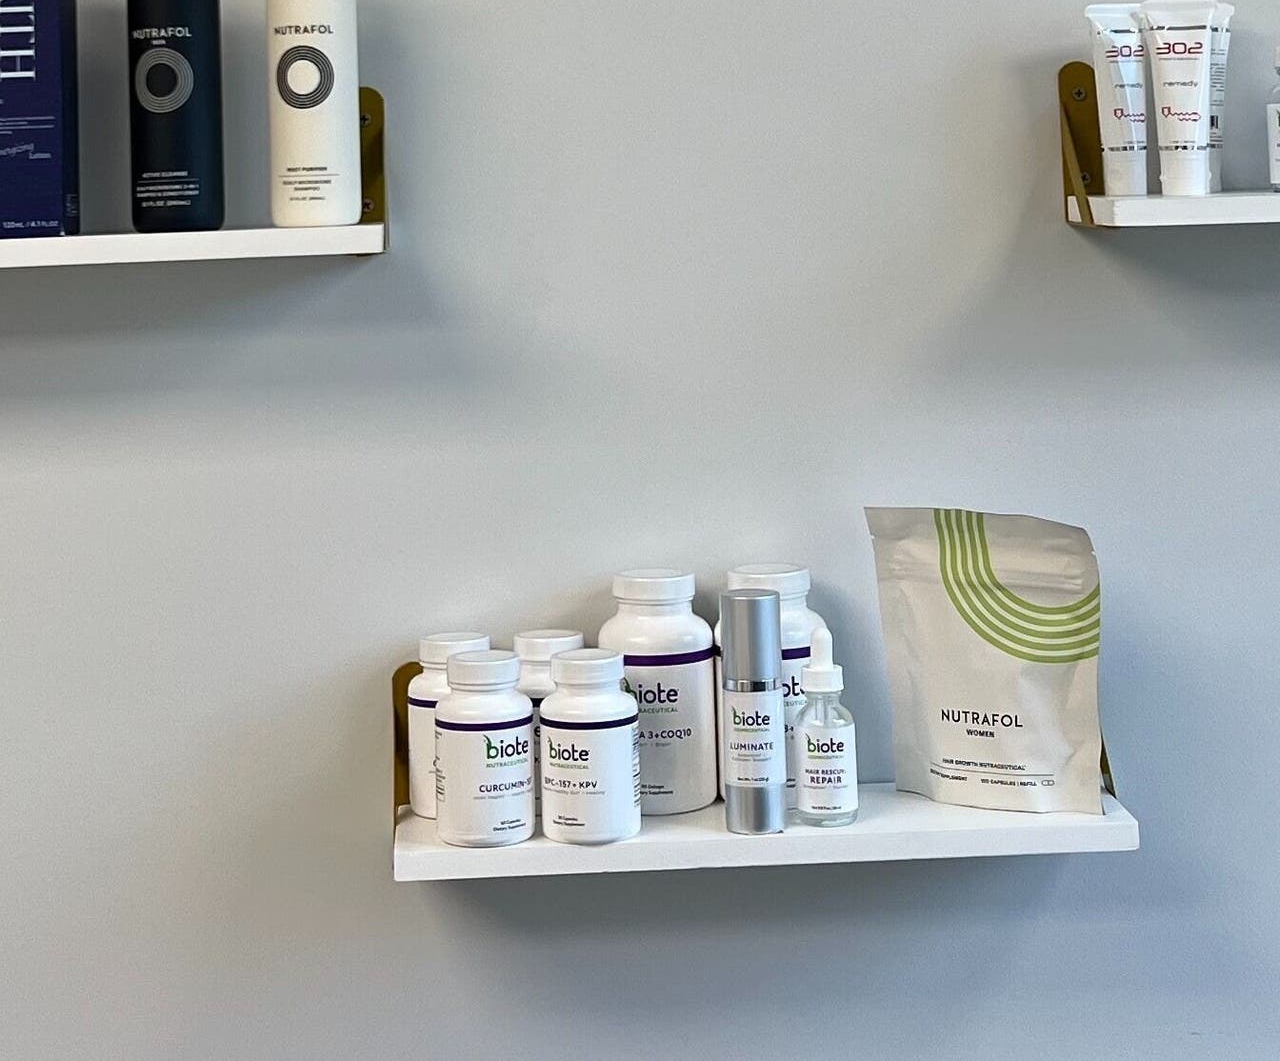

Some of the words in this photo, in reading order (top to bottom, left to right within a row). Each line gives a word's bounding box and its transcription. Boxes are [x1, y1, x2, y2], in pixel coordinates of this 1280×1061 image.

[132, 25, 192, 39] NUTRAFOL
[274, 24, 334, 36] NUTRAFOL
[1105, 45, 1145, 58] 302
[1156, 42, 1203, 55] 302
[1163, 80, 1198, 88] remedy
[731, 706, 770, 726] biote
[941, 709, 1023, 728] NUTRAFOL
[966, 729, 995, 738] WOMEN
[483, 734, 529, 759] biote
[548, 736, 590, 761] biote
[730, 742, 774, 751] LUMINATE
[805, 733, 844, 753] biote
[579, 780, 598, 789] KPV
[809, 776, 842, 784] REPAIR
